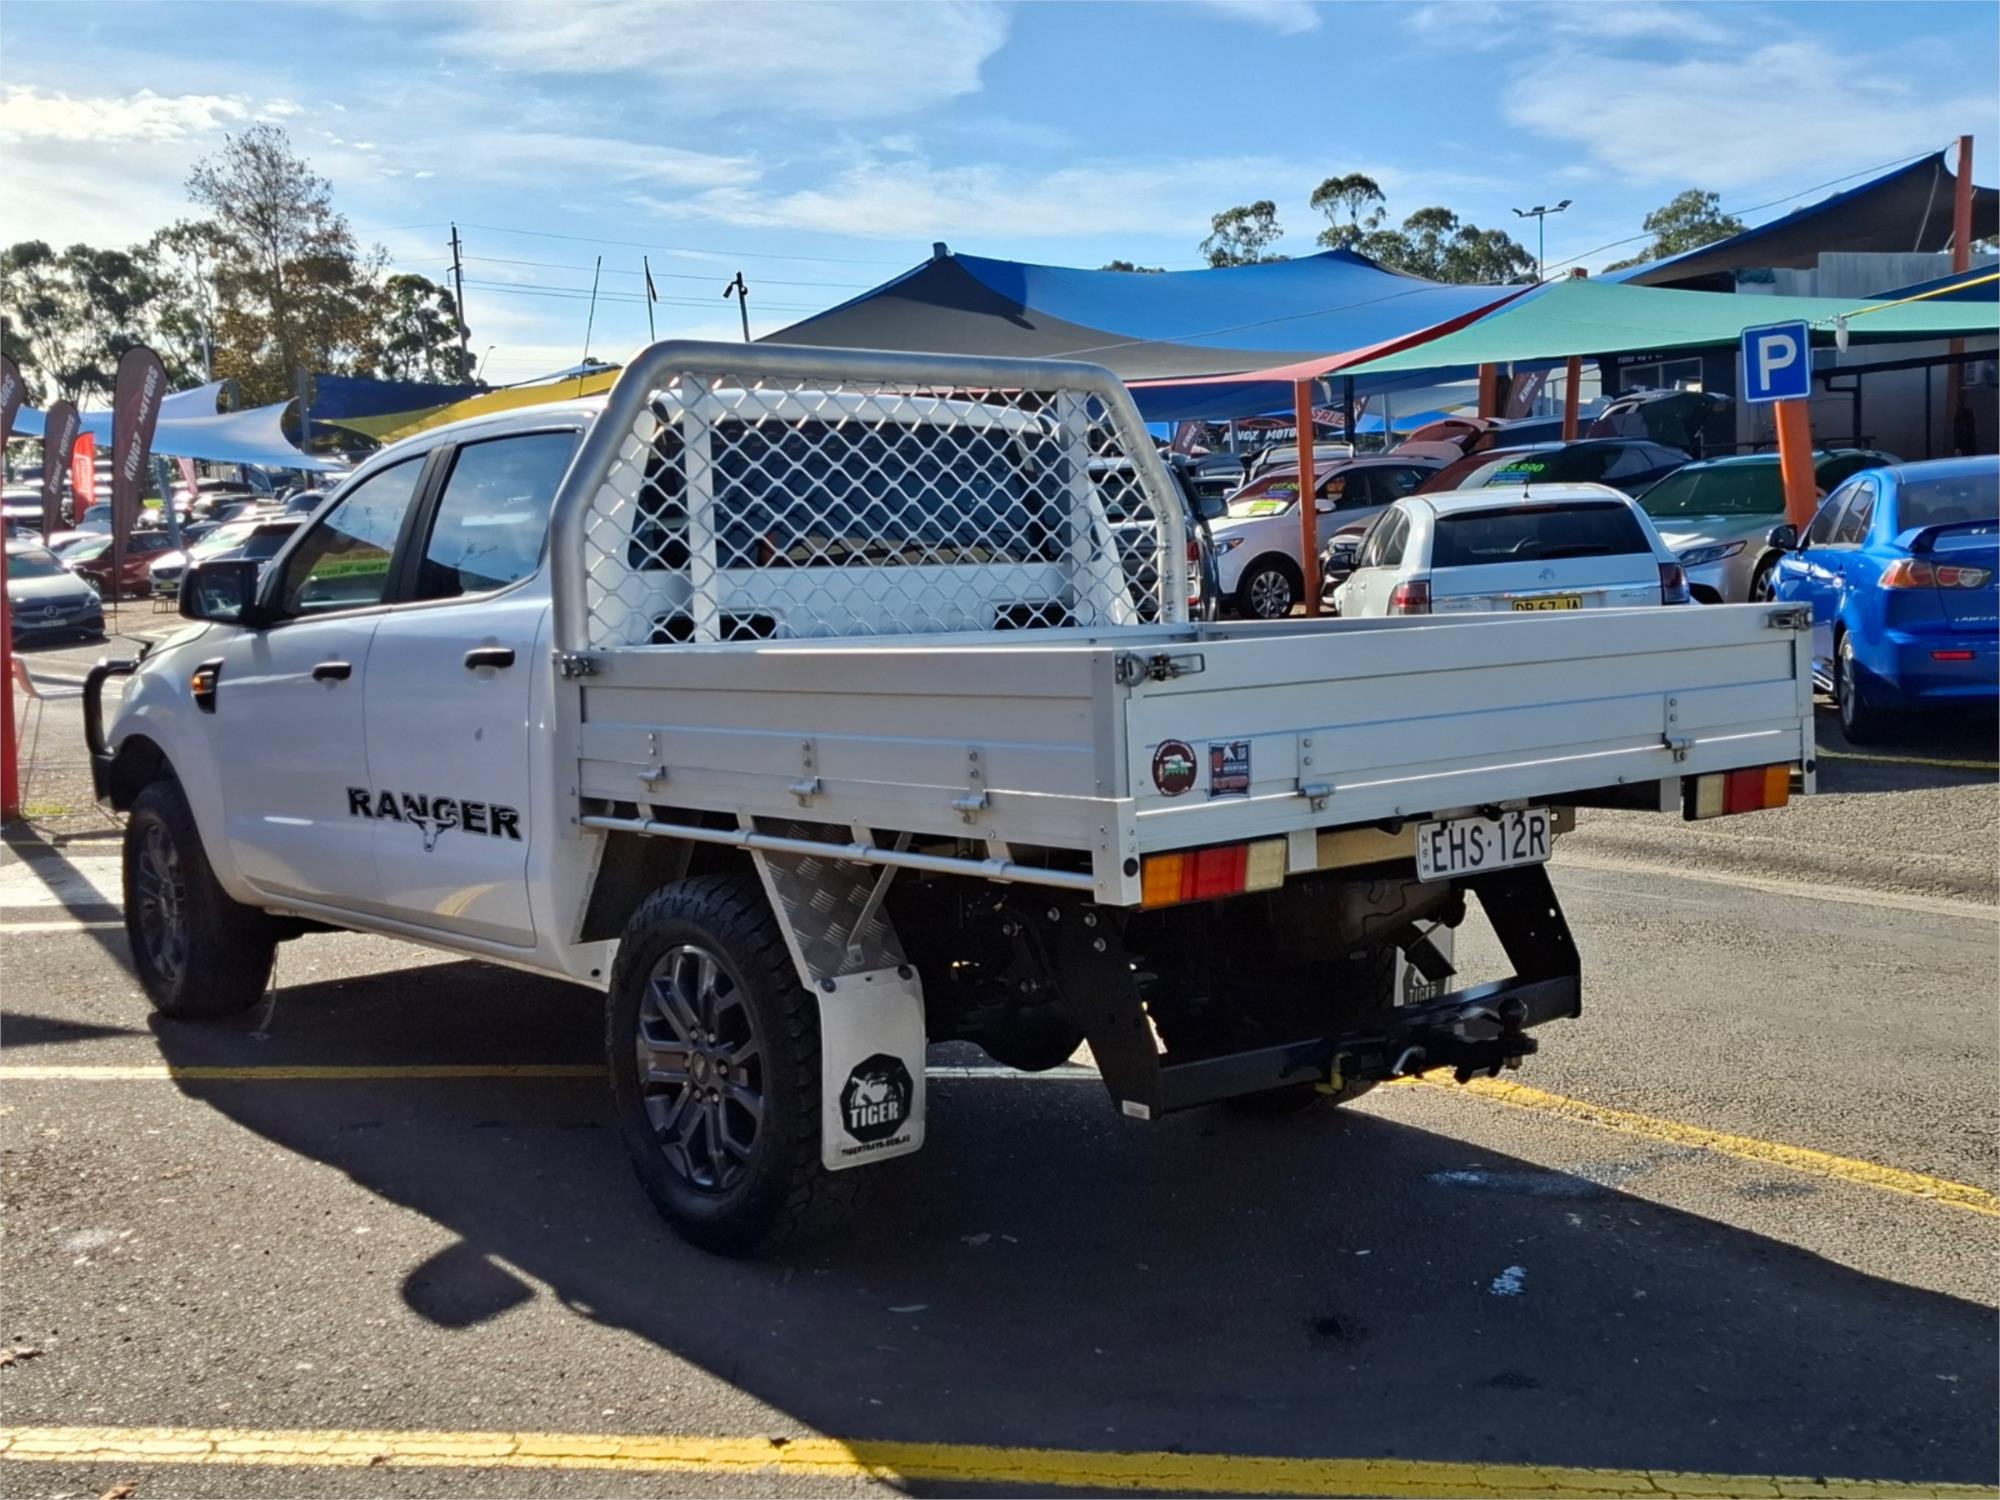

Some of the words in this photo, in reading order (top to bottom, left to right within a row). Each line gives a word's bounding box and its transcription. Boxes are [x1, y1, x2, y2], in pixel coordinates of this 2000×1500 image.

[1759, 334, 1797, 391] P
[1518, 373, 1539, 402] KINGZ
[1312, 408, 1345, 426] SALE
[1265, 427, 1297, 440] MOTO
[124, 431, 142, 481] KINGZ
[346, 786, 522, 842] RANGER
[849, 1101, 899, 1129] TIGER
